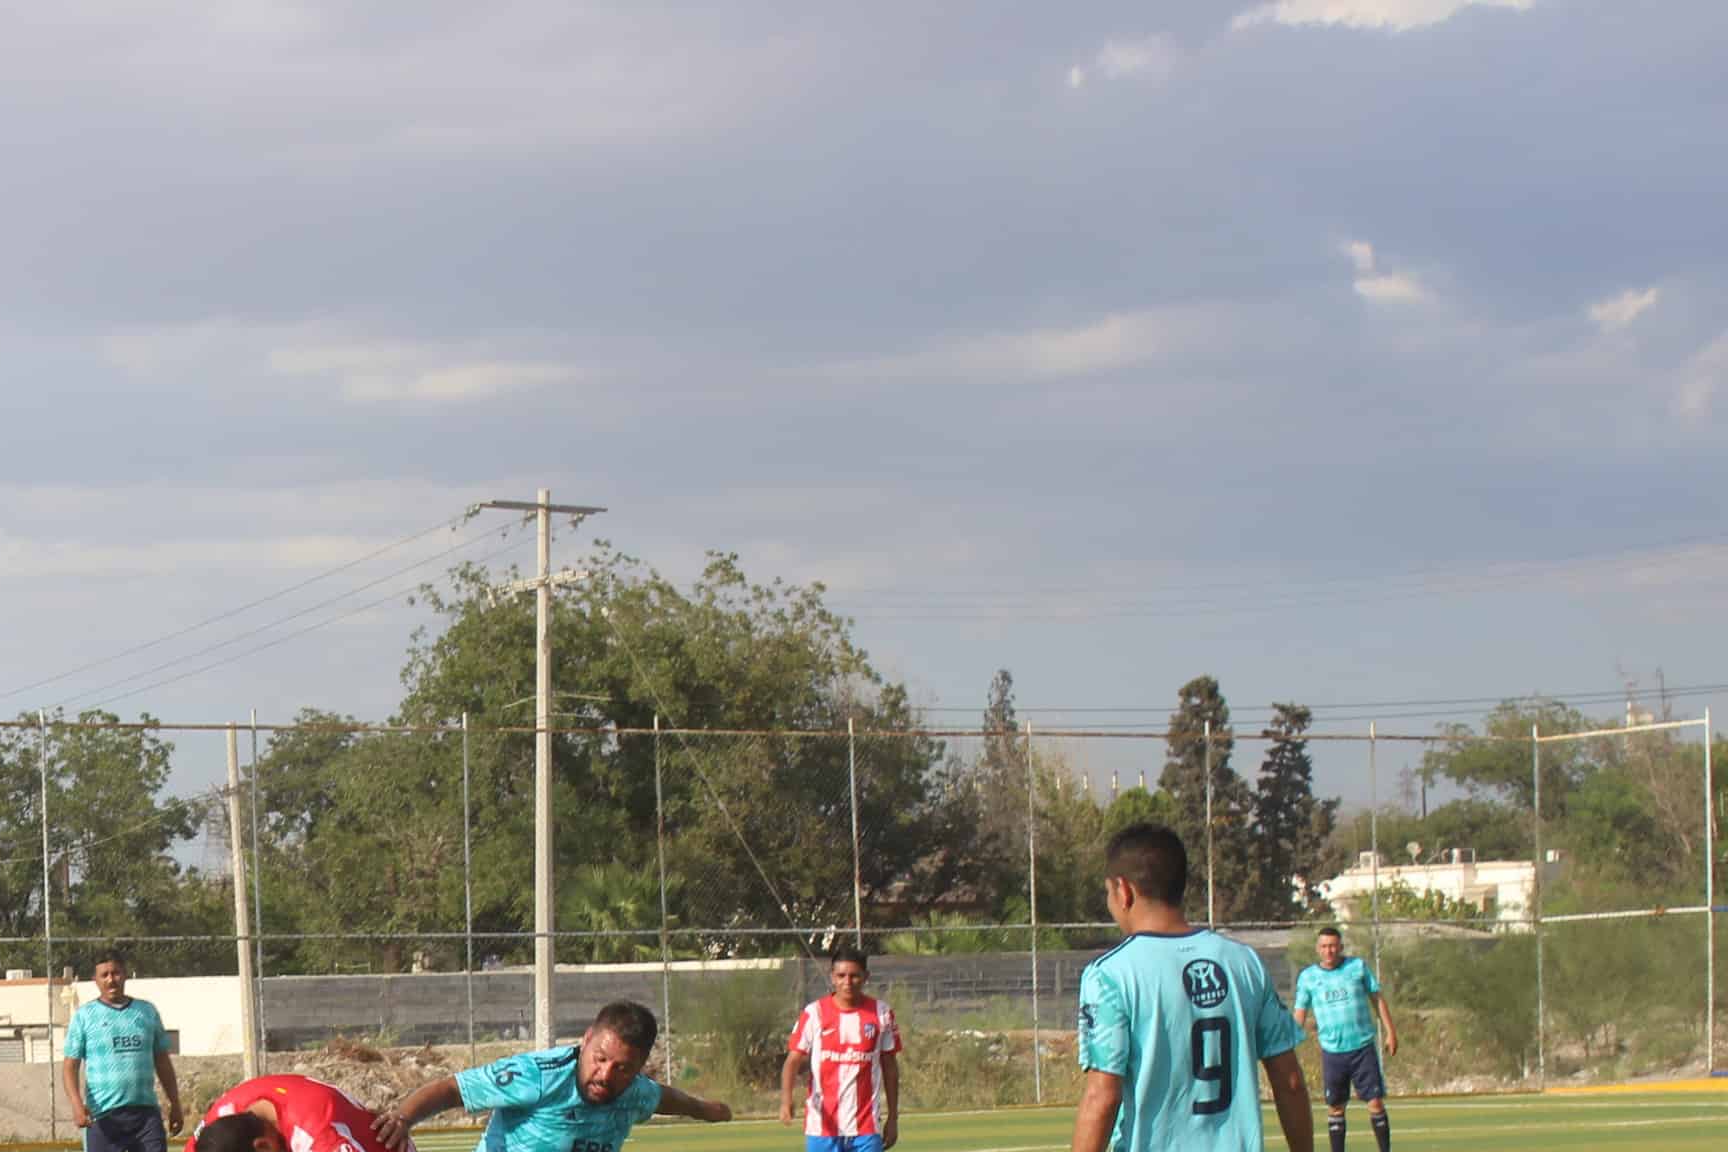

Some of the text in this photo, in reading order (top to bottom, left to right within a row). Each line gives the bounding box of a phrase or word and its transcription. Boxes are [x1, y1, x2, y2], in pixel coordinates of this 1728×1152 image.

[112, 1034, 143, 1048] FBS
[821, 1047, 874, 1062] Plus50
[1191, 1015, 1232, 1115] 9
